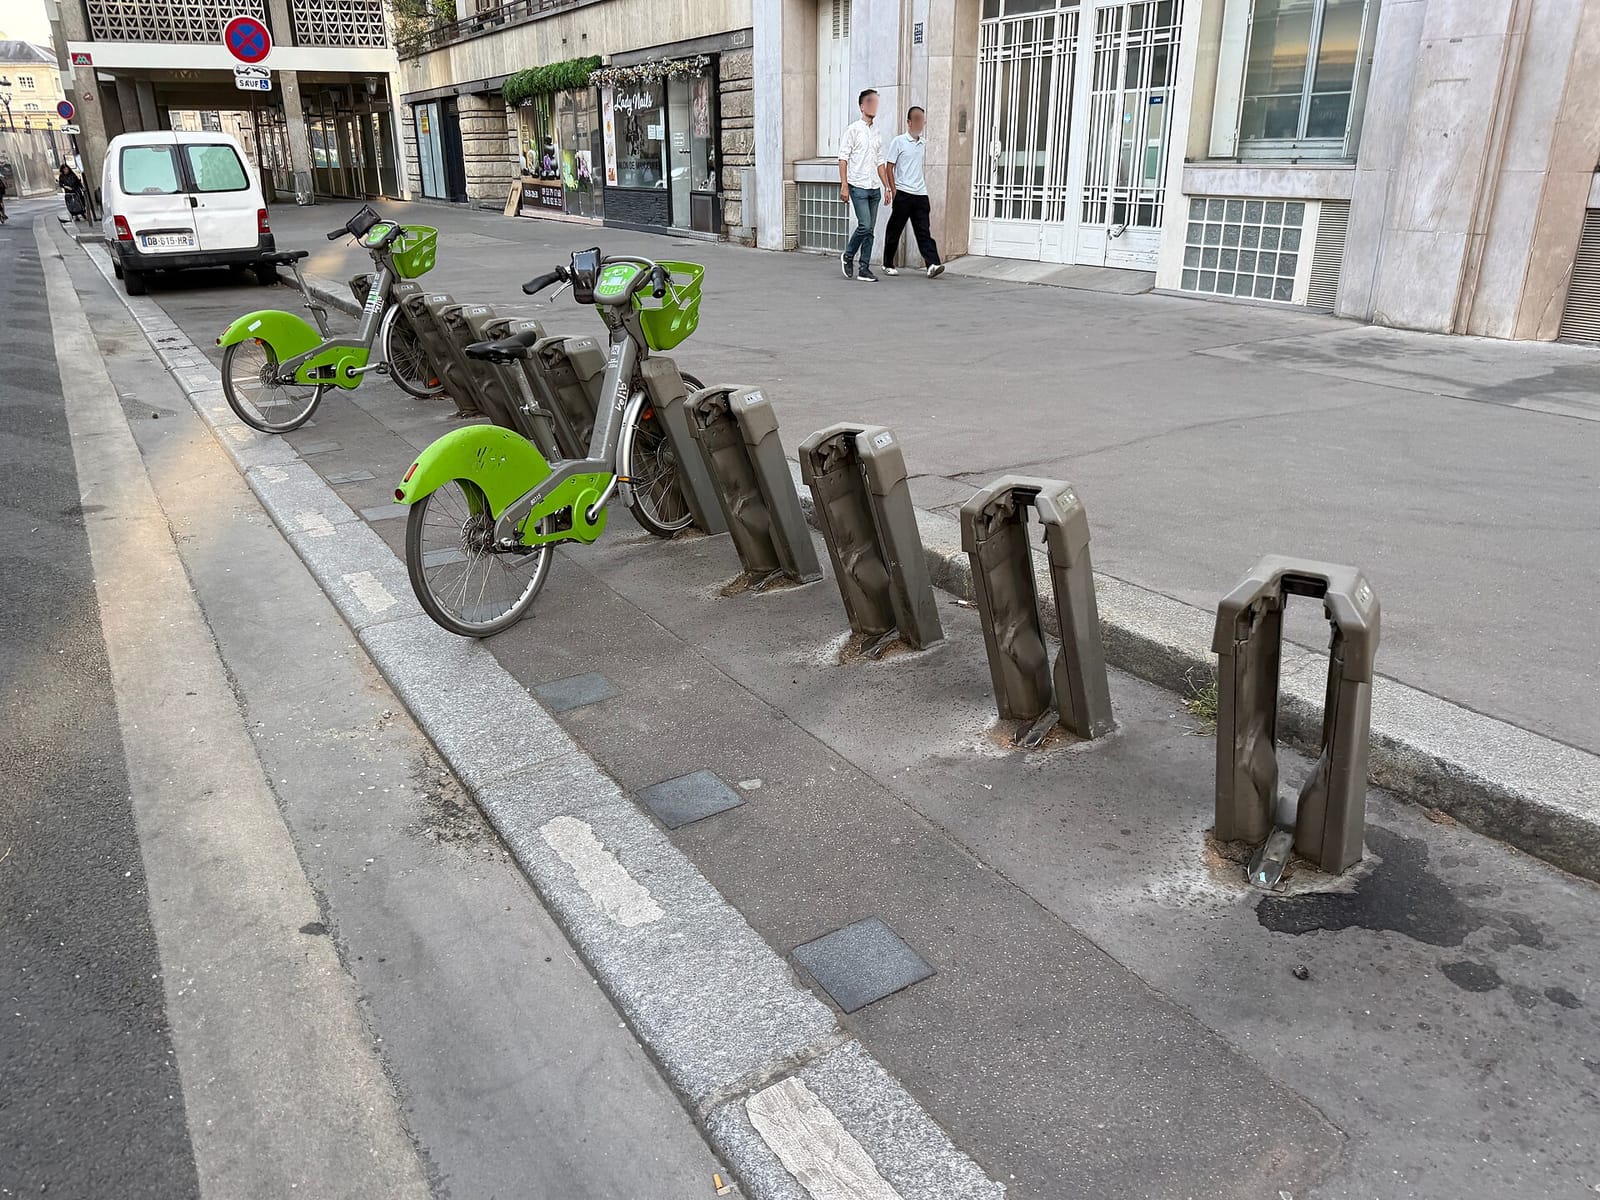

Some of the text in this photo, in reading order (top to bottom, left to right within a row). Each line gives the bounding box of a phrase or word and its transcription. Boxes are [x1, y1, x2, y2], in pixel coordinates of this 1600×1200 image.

[239, 79, 259, 88] SAUF
[613, 88, 654, 117] Lady Nails
